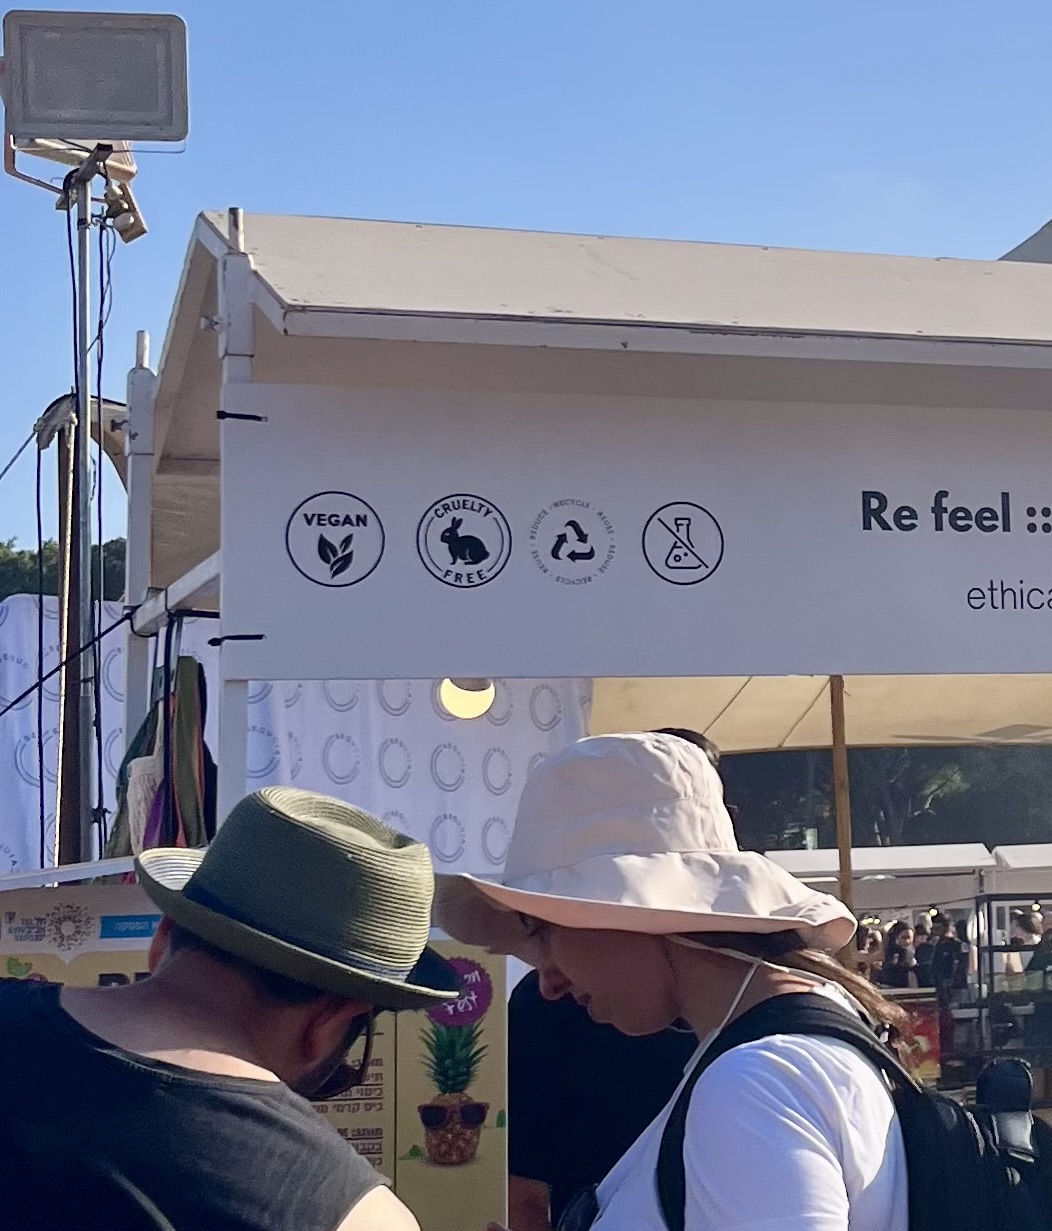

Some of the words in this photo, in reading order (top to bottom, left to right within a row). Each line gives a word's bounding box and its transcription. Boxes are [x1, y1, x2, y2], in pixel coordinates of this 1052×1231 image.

[433, 499, 494, 519] CRUELTY
[553, 498, 591, 509] RECYCLE
[861, 490, 919, 532] Re
[930, 489, 1012, 533] feel
[303, 513, 368, 527] VEGAN
[442, 568, 488, 584] FREE
